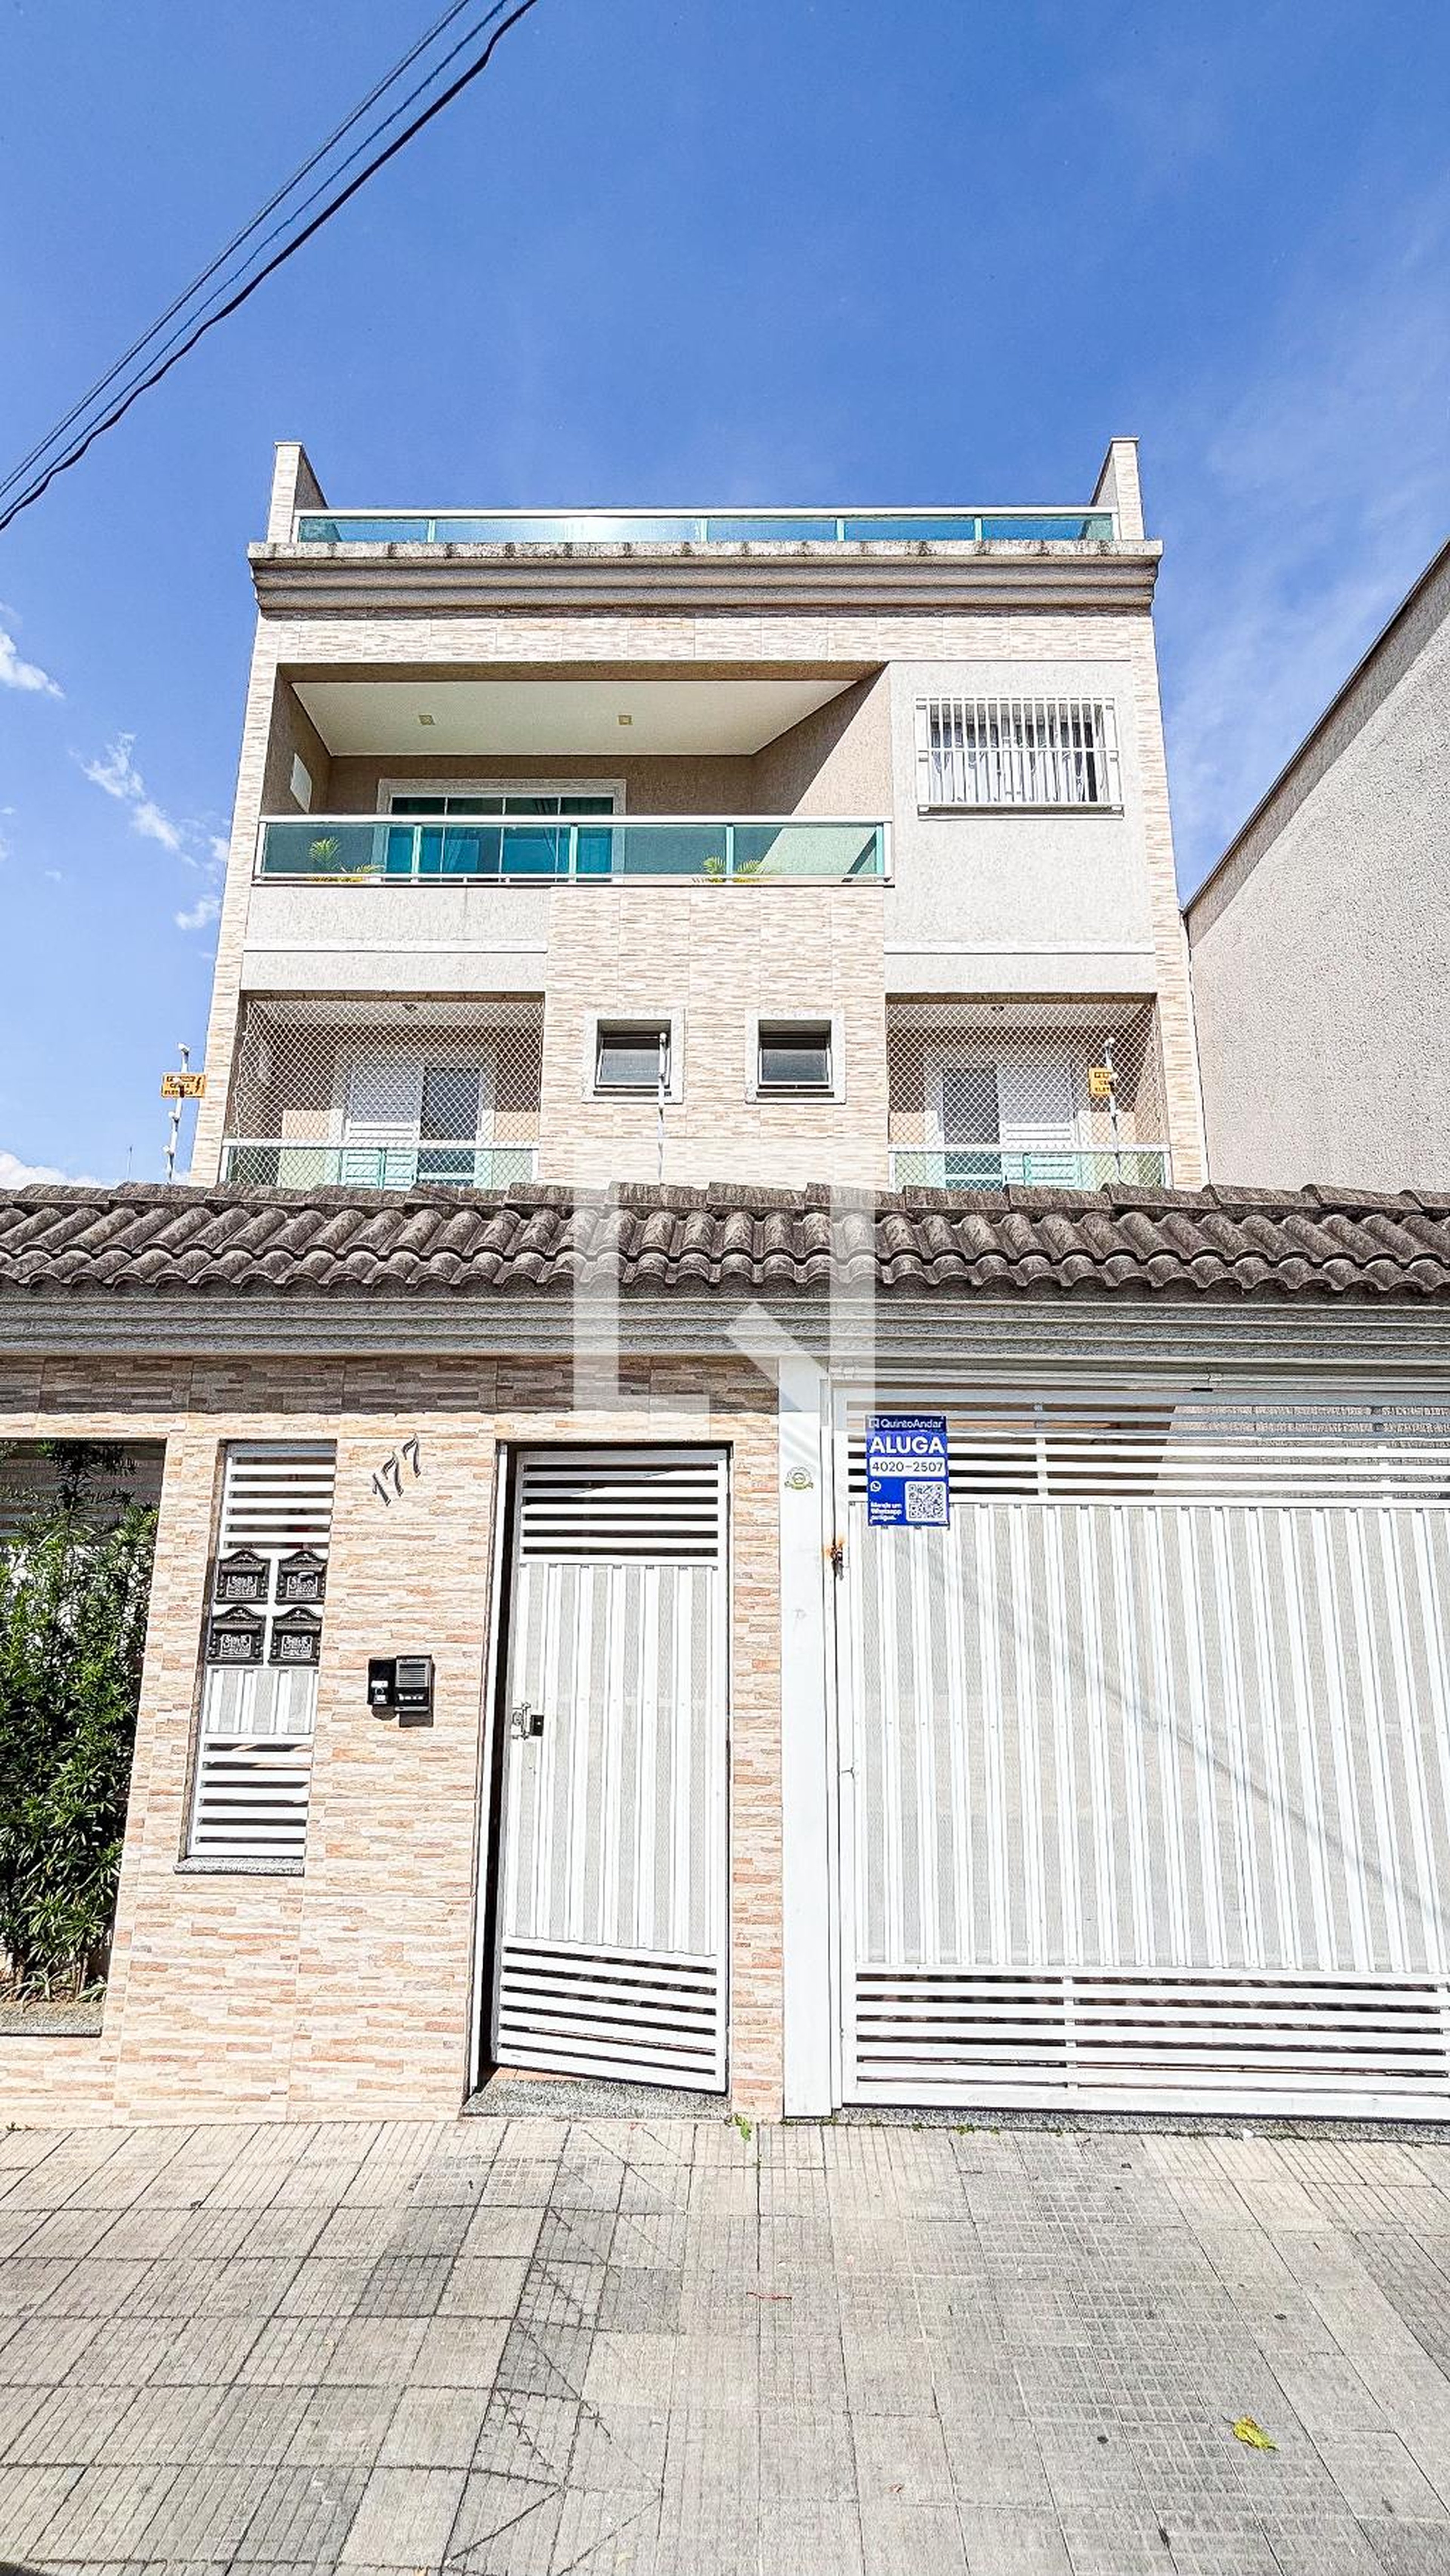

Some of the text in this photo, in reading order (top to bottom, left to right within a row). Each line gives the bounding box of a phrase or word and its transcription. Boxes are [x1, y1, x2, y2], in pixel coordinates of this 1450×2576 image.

[881, 1418, 943, 1428] QuintoAndar
[869, 1436, 944, 1454] ALUGA
[372, 1432, 421, 1506] 177
[872, 1462, 943, 1472] 4020-2507
